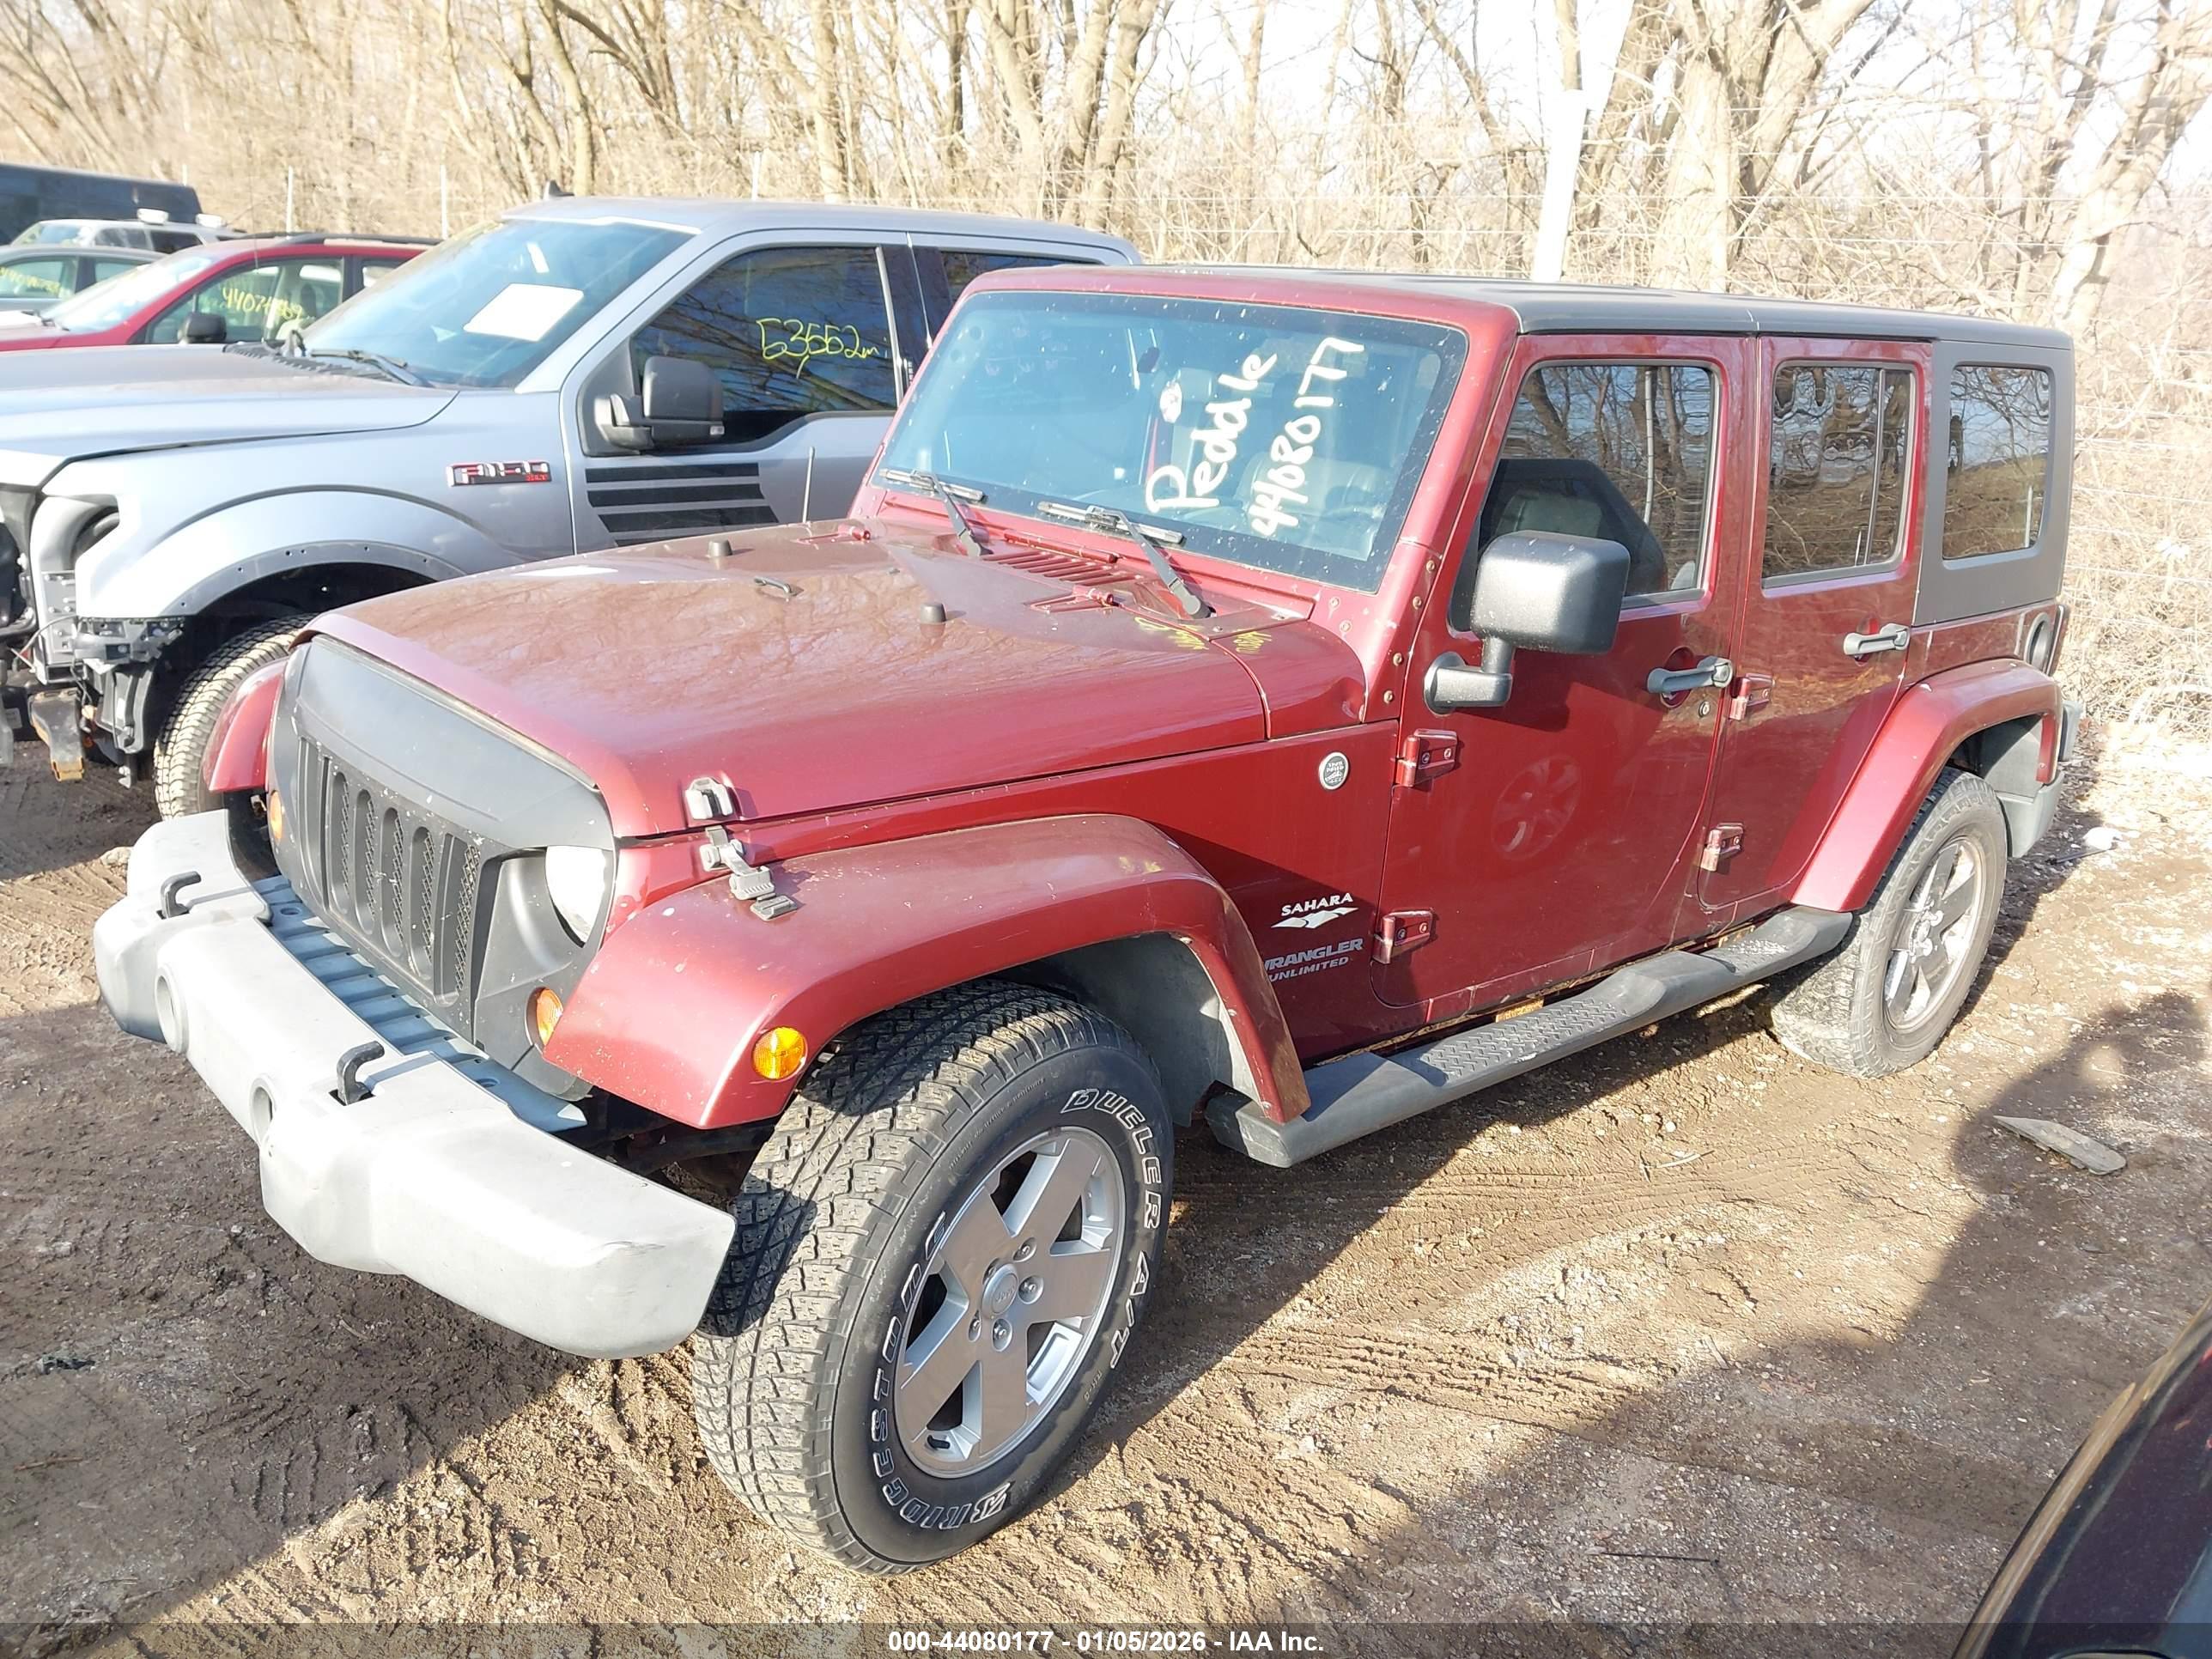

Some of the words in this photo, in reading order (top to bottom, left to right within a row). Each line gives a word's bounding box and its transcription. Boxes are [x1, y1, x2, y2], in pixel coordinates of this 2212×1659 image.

[1145, 352, 1278, 514] Peddle
[1248, 337, 1364, 537] 44080177
[1268, 957, 1349, 982] UNLIMITED
[1281, 893, 1354, 917] SAHARA
[1060, 1089, 1161, 1229] DUELER
[871, 1211, 1013, 1531] BRIDGESTONE
